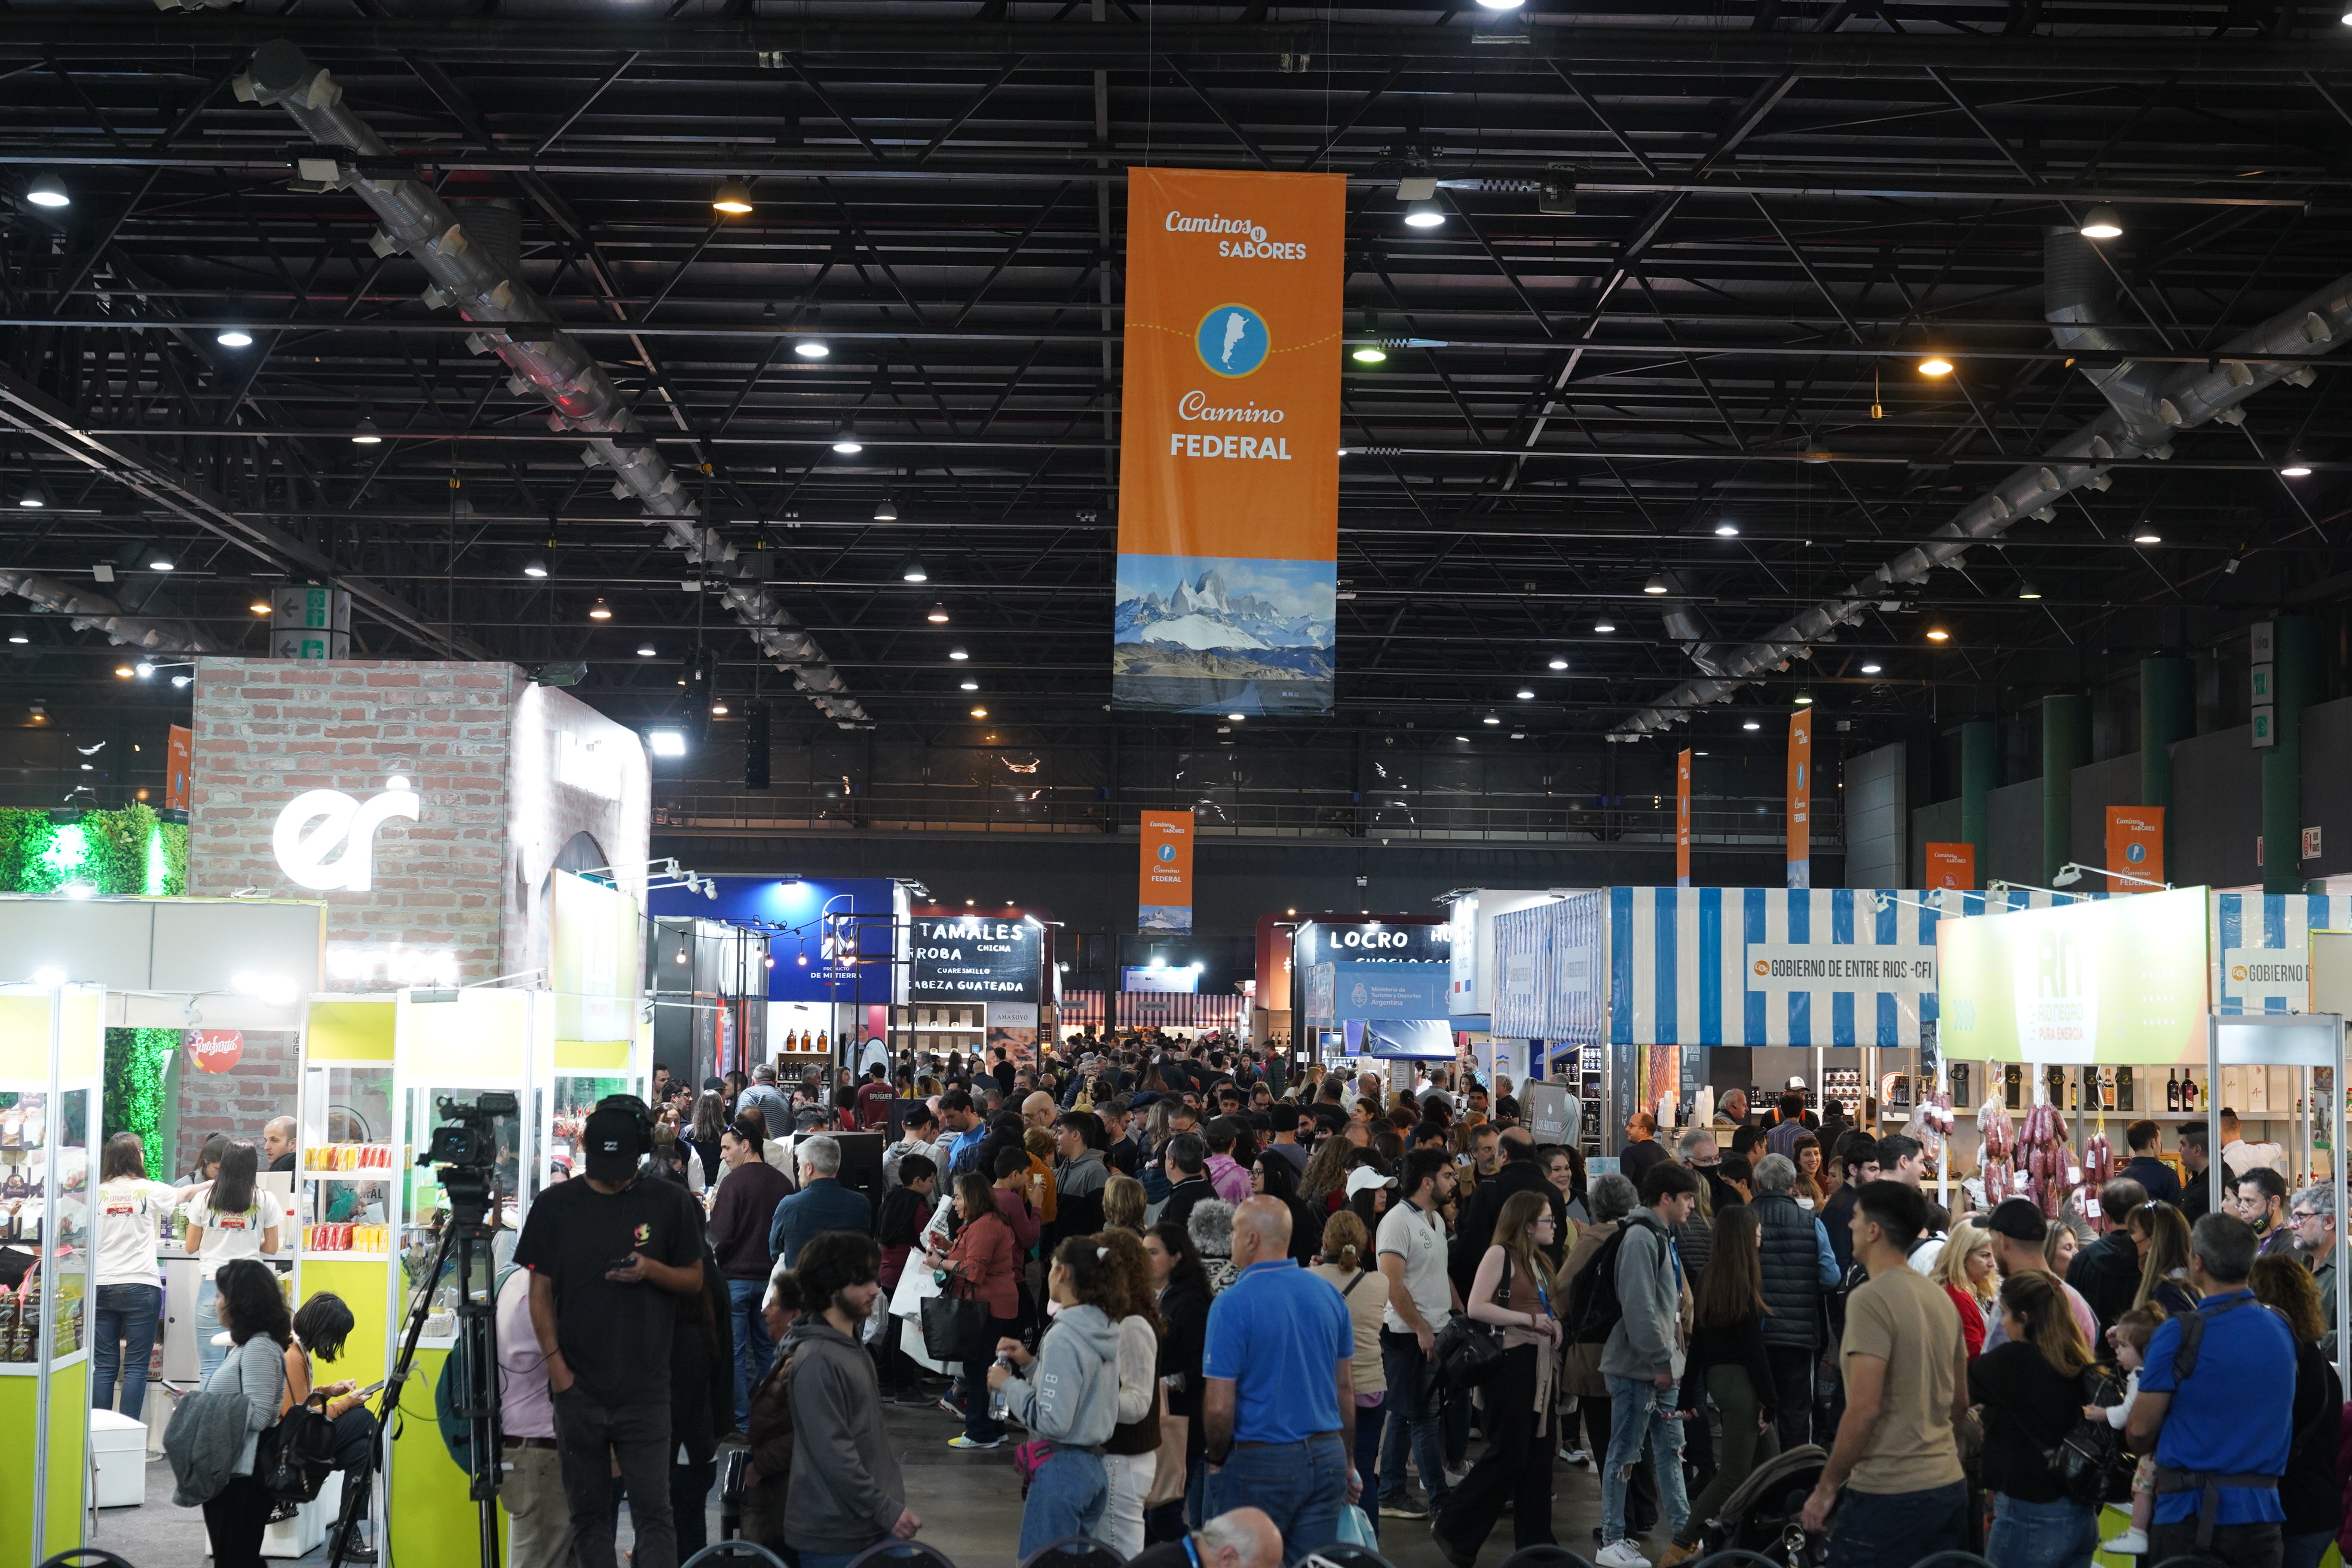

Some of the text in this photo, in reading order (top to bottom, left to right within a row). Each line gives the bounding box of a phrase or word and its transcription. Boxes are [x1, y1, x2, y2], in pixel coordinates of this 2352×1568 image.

[1165, 210, 1251, 234] Caminos
[1219, 240, 1306, 259] SABORES
[1178, 390, 1284, 423] Camino
[1171, 433, 1292, 460] FEDERAL
[1153, 865, 1180, 873] Camino
[2121, 866, 2151, 876] Camino
[919, 923, 1024, 941] TAMALES
[1330, 931, 1408, 948] LOCRO
[1771, 959, 1825, 977] GOBIERNO
[1829, 960, 1842, 977] DE
[1845, 960, 1879, 978] ENTRE
[1883, 961, 1907, 978] RIOS
[2249, 964, 2302, 982] GOBIERNO
[957, 981, 1024, 992] GUATEADA
[2039, 1027, 2056, 1040] PURA
